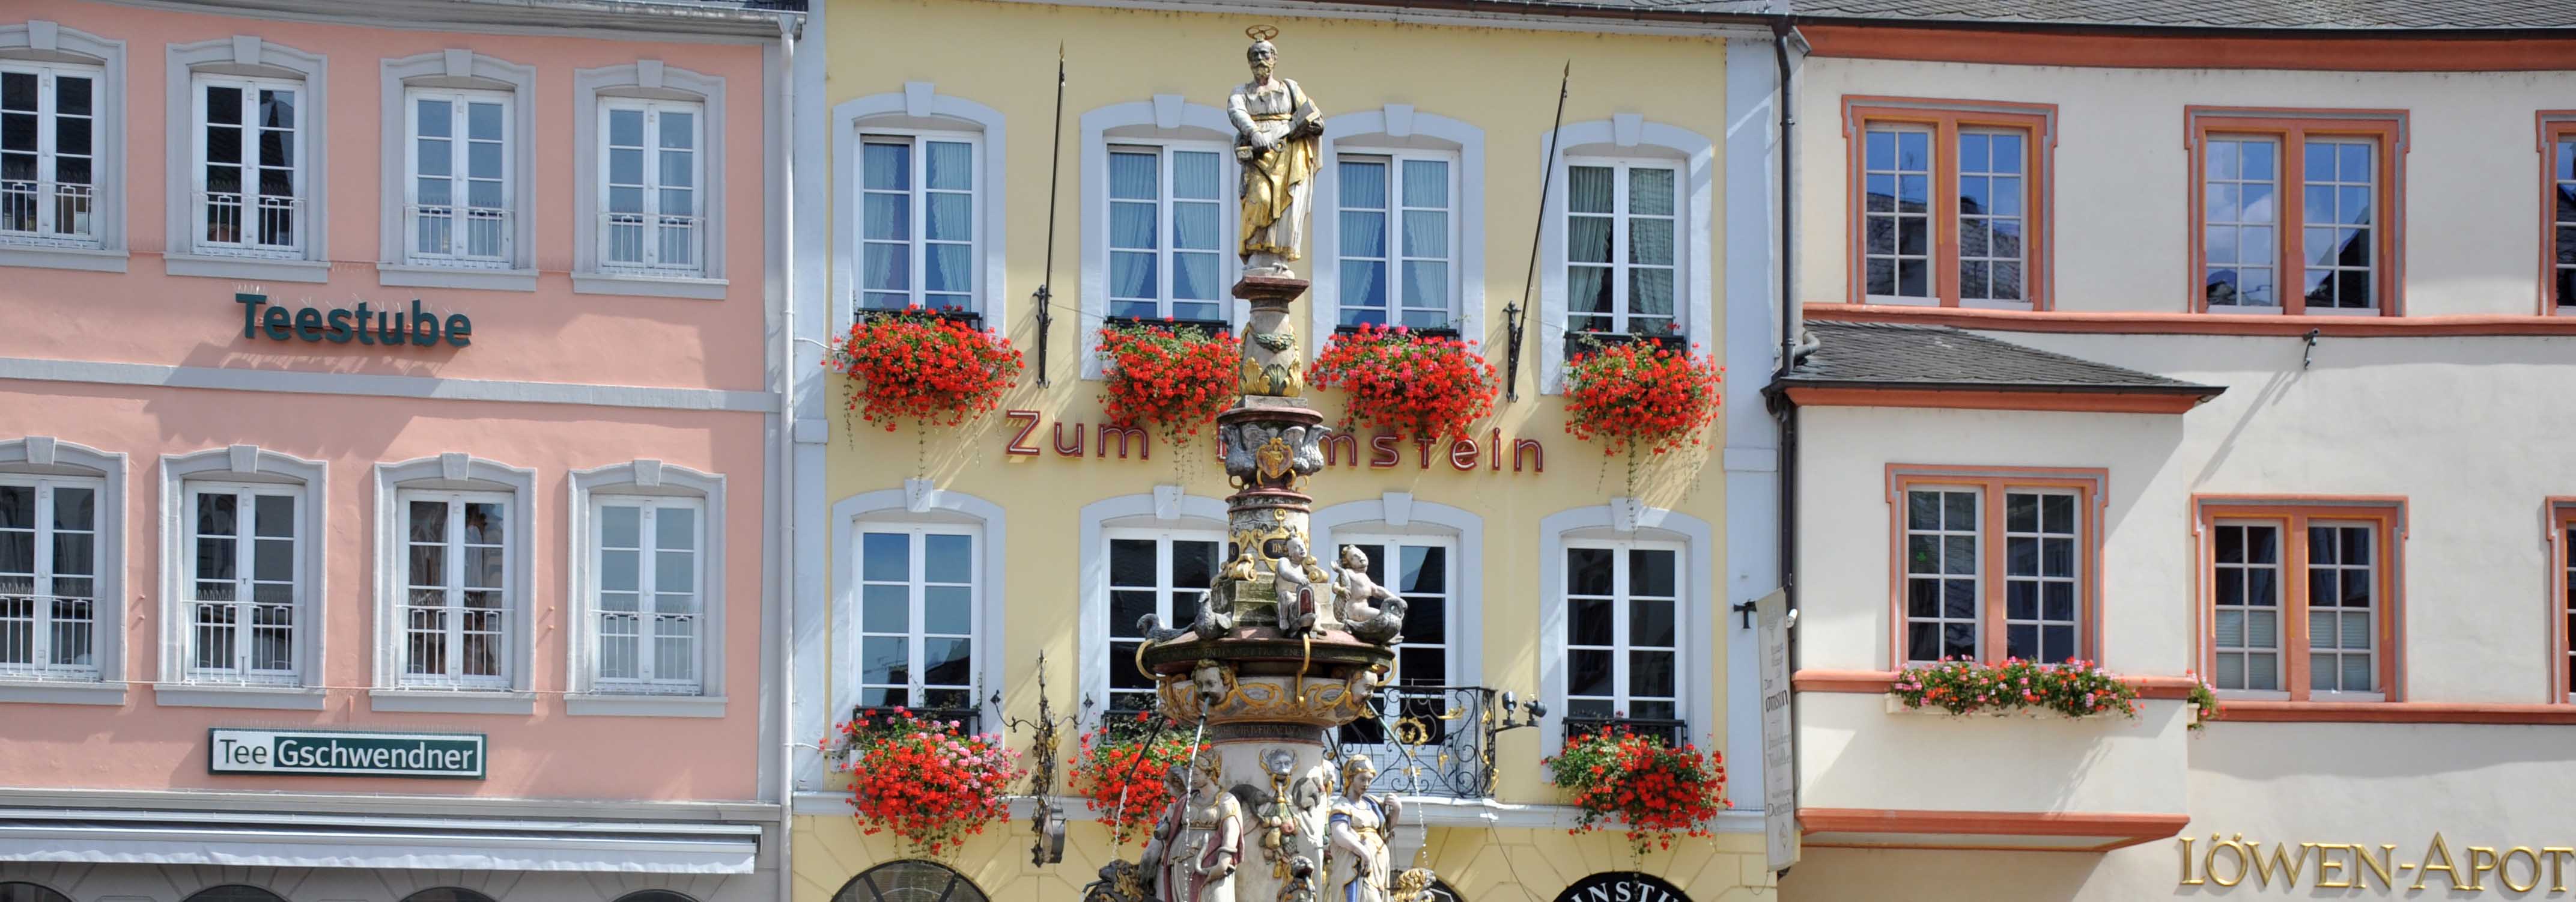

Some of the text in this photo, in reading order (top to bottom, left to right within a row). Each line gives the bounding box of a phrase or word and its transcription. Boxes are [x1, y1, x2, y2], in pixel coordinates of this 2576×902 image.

[235, 292, 472, 347] Teestube
[1006, 410, 1149, 460] Zum
[219, 738, 473, 769] Tee Gschwendner
